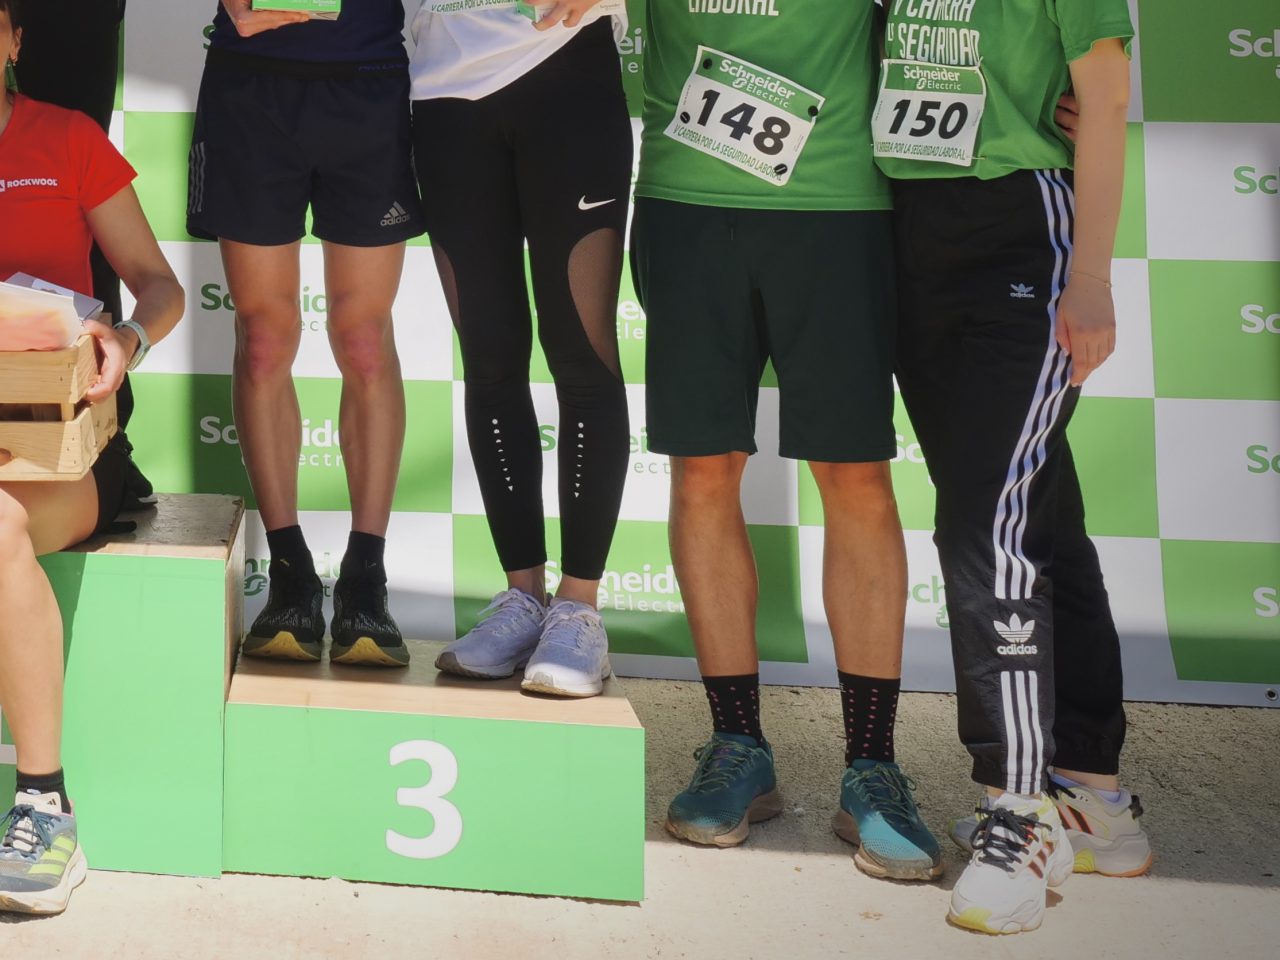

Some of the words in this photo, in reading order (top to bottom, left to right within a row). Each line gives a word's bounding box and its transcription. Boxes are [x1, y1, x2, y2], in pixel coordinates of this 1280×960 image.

[719, 58, 797, 100] Schneider
[903, 65, 961, 82] Schneider
[927, 80, 962, 91] Electric
[696, 88, 792, 156] 148
[888, 98, 969, 140] 150
[7, 177, 58, 189] ROCKWOOL
[996, 643, 1039, 656] adidas
[385, 738, 464, 860] 3
